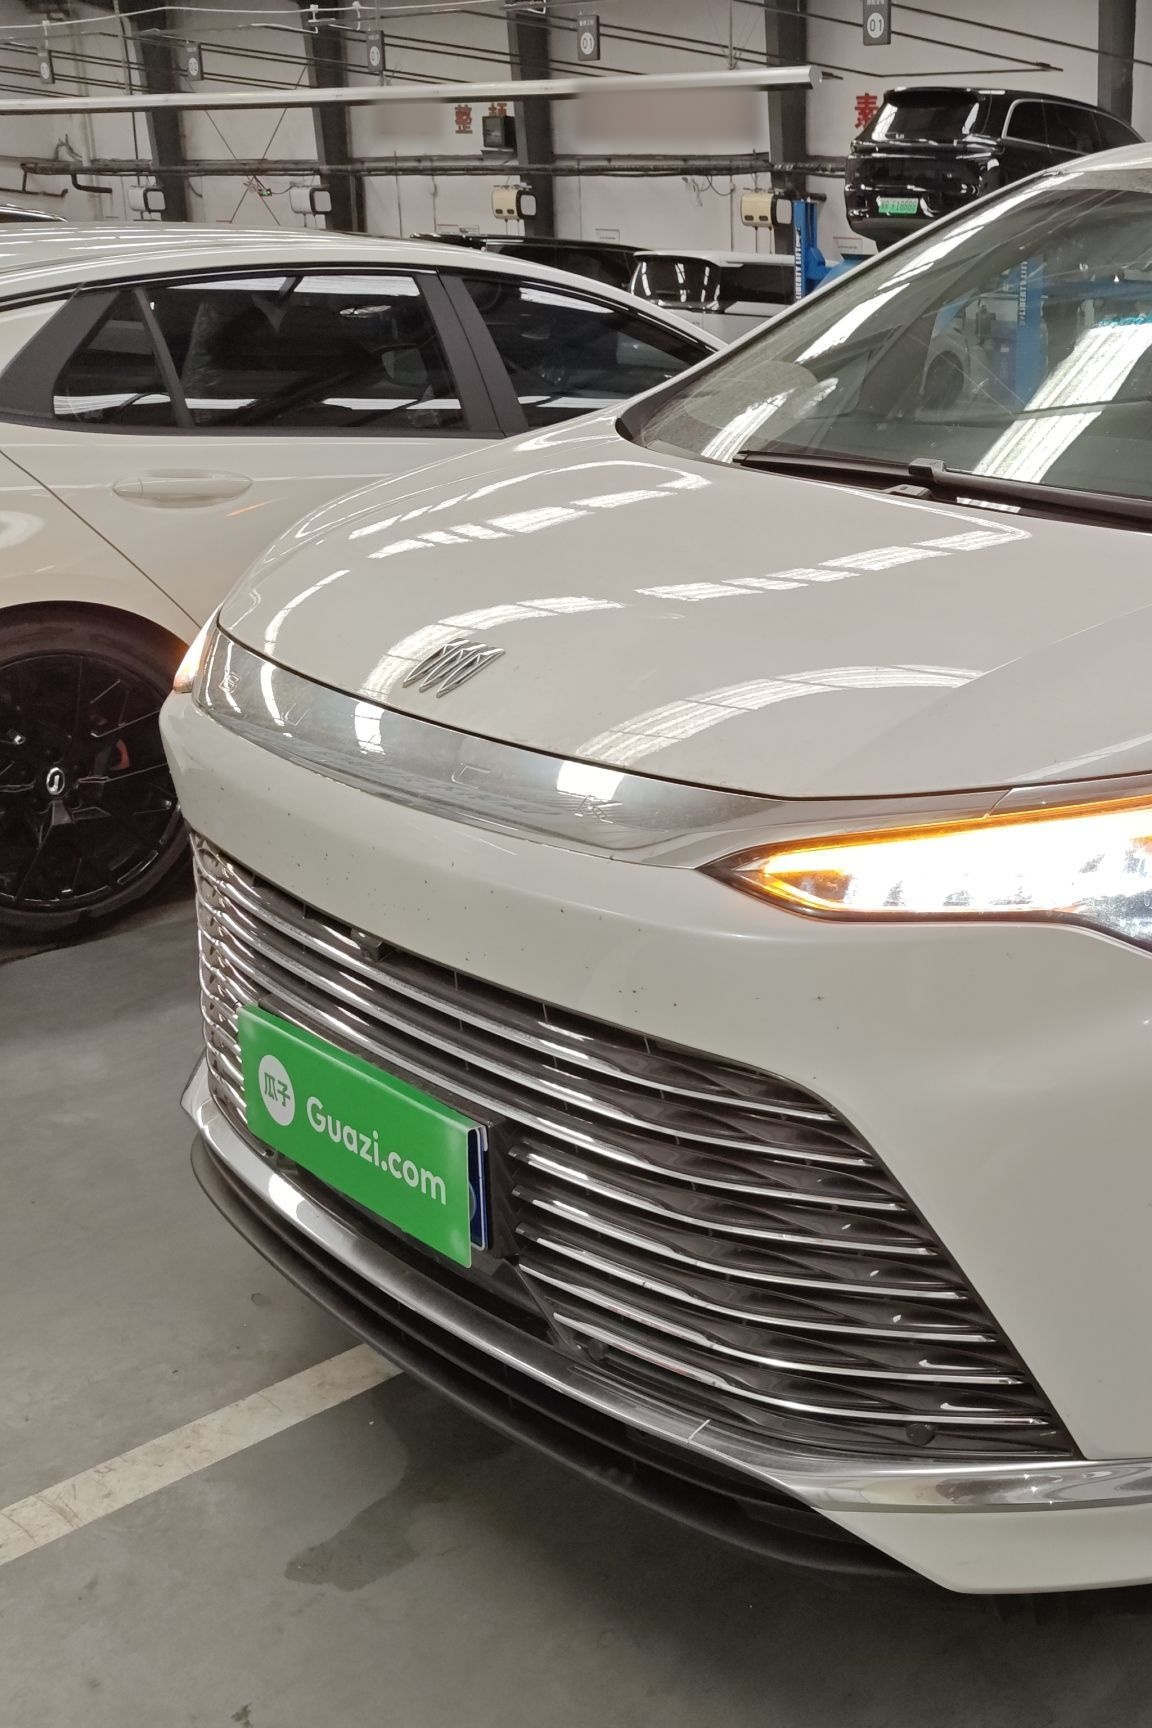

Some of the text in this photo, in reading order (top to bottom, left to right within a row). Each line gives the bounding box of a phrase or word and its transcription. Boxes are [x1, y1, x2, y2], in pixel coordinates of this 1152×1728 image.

[869, 19, 882, 32] 01
[262, 1071, 291, 1109] 瓜子
[305, 1095, 447, 1206] Guazi.com
